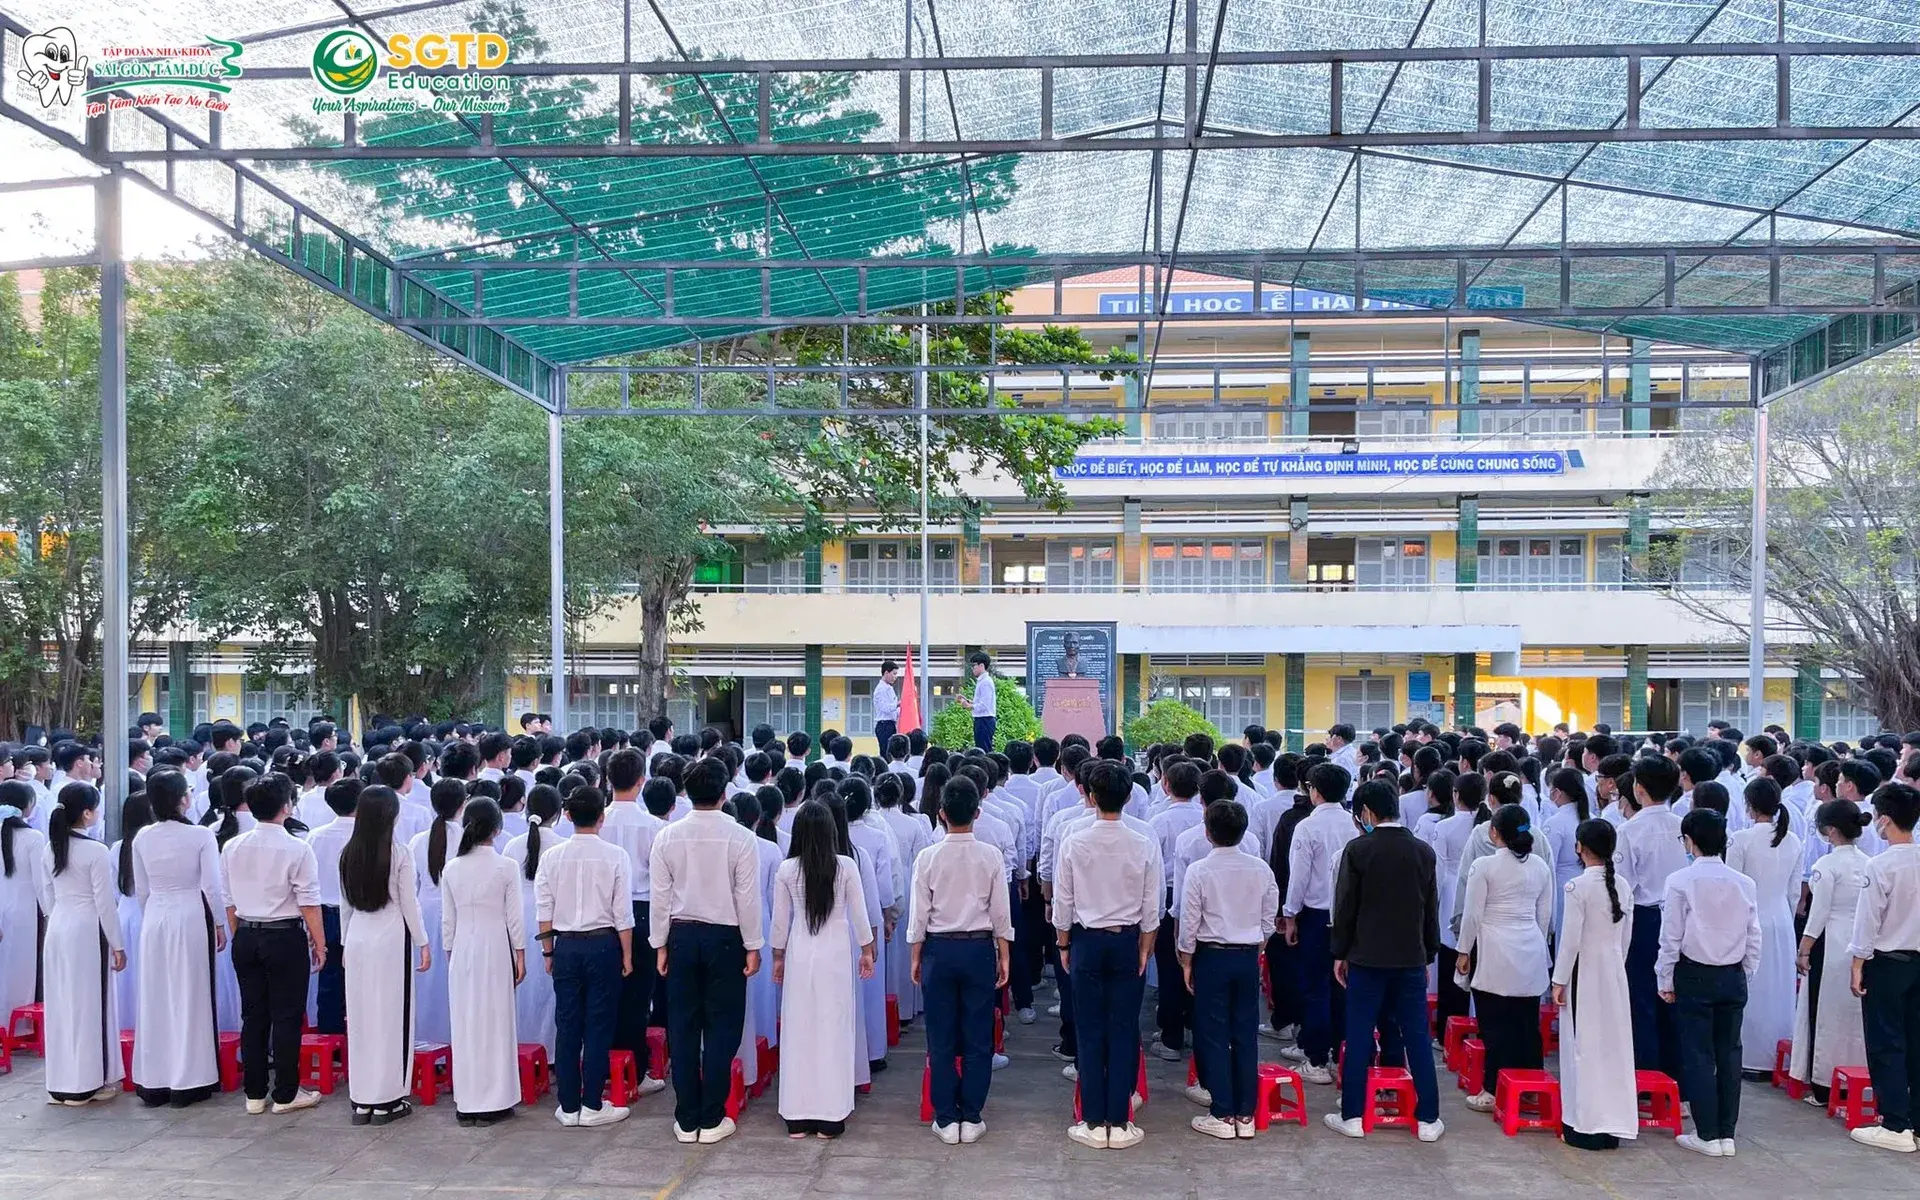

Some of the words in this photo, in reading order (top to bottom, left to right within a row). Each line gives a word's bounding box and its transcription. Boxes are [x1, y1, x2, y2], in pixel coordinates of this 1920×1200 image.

[1090, 458, 1105, 473] ĐỂ
[1108, 459, 1137, 476] BIẾT,
[1140, 463, 1163, 476] HỌC
[1167, 457, 1183, 473] ĐỂ
[1186, 461, 1213, 475] LÀM,
[1216, 461, 1240, 475] HỌC
[1243, 457, 1259, 472] ĐỂ
[1262, 459, 1279, 475] TỰ
[1325, 460, 1354, 475] ĐỊNH
[1394, 460, 1418, 474] HỌC
[1422, 454, 1438, 471] ĐỂ
[1440, 456, 1473, 470] CÙNG
[1477, 458, 1519, 470] CHUNG
[1522, 454, 1556, 470] SỐNG
